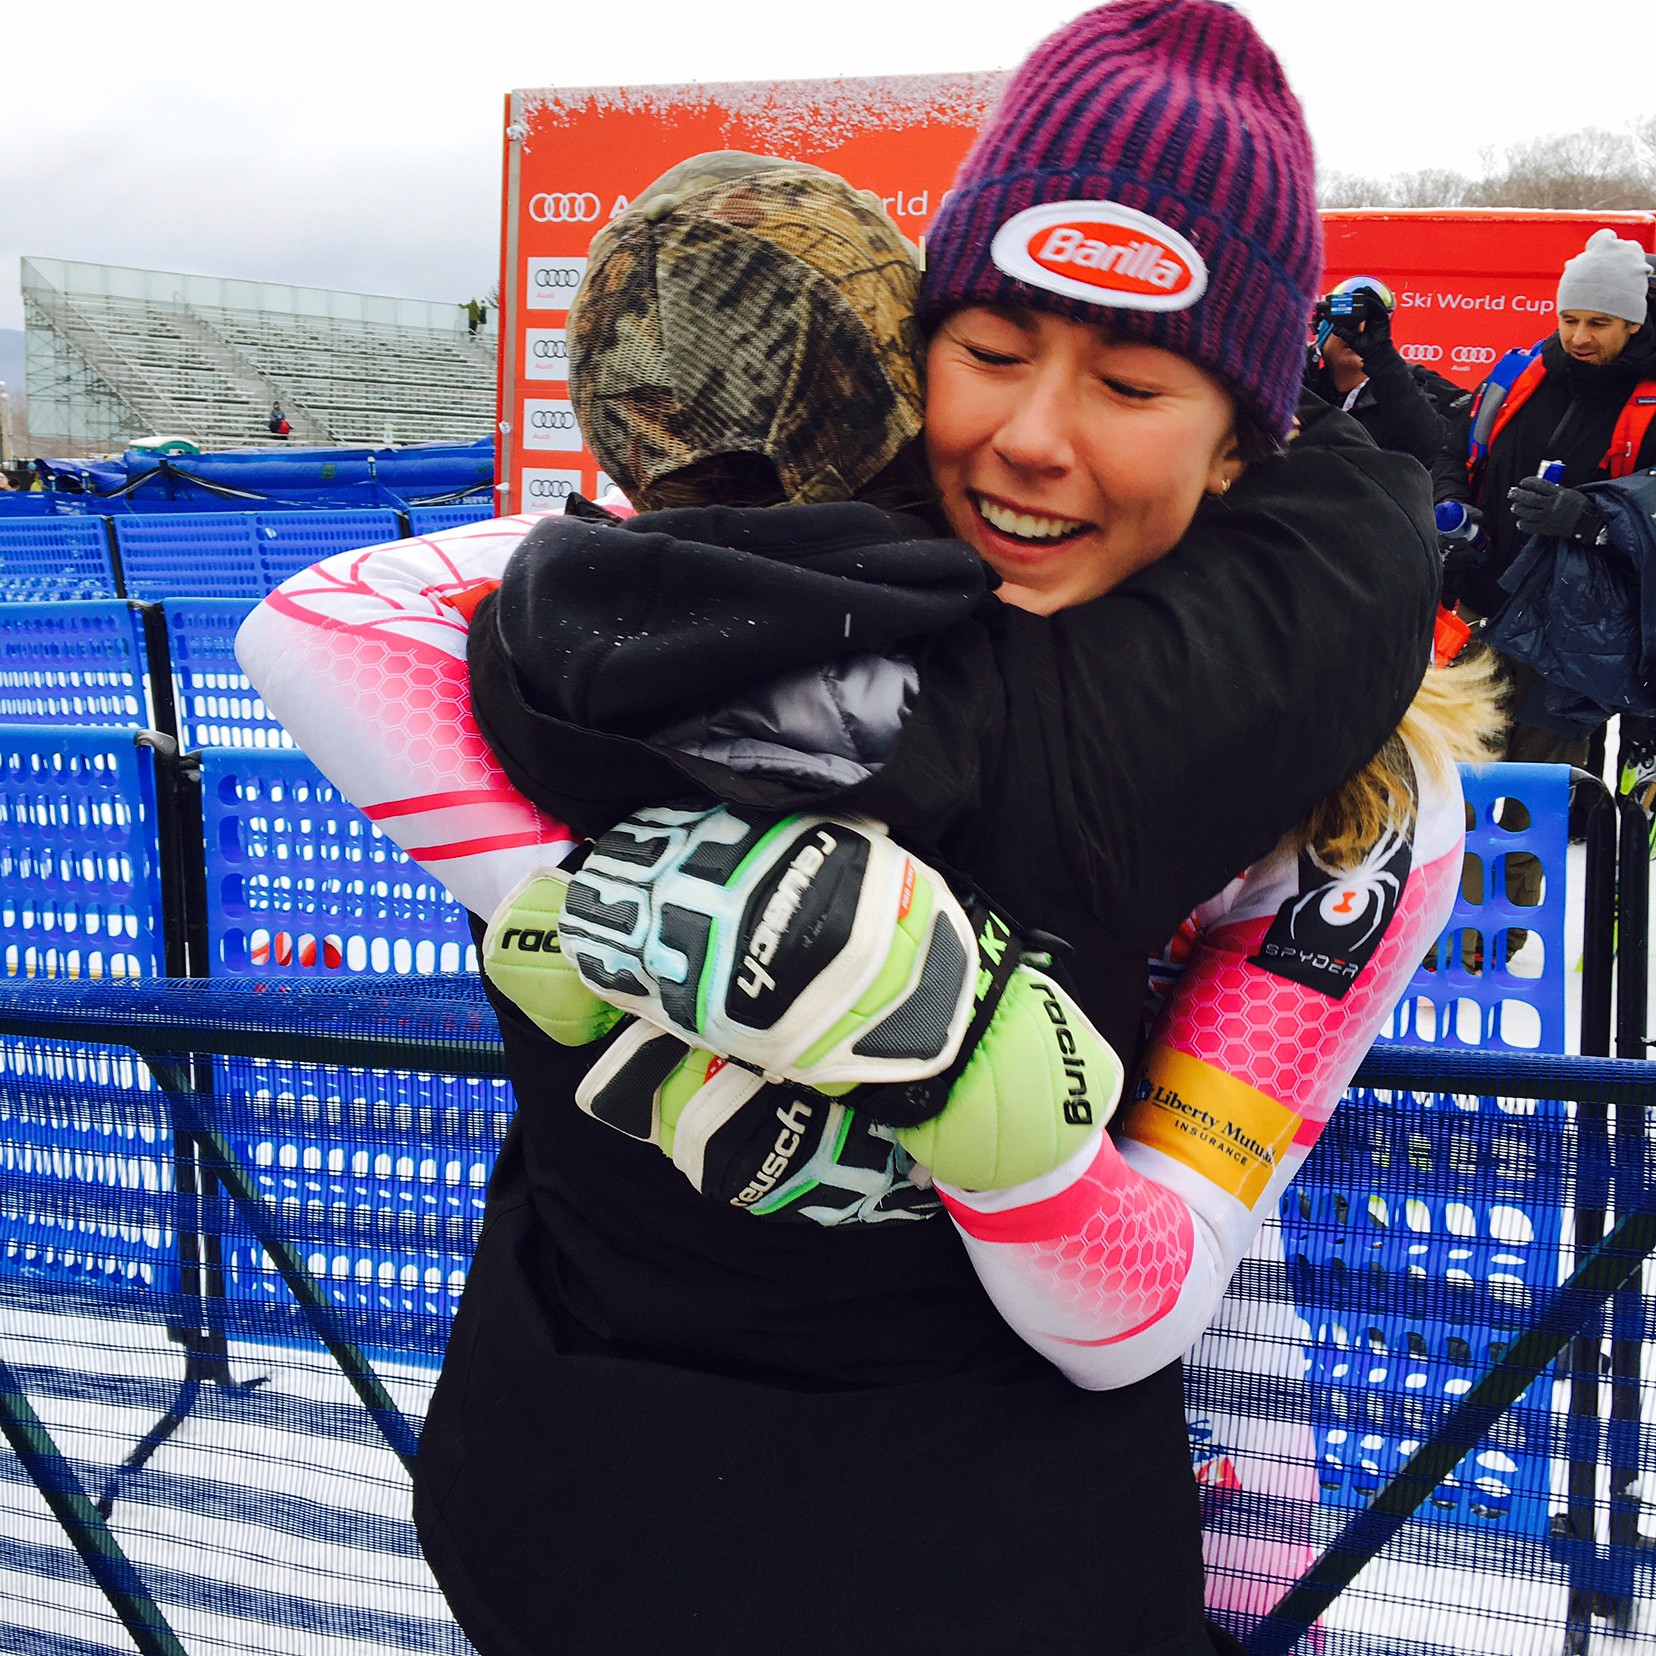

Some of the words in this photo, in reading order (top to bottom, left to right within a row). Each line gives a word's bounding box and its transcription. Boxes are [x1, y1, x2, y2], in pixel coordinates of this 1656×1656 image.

[882, 189, 928, 217] rld
[1038, 227, 1183, 290] Barilla
[1400, 292, 1432, 309] Ski
[1436, 293, 1505, 312] World
[1511, 295, 1554, 315] Cup
[534, 362, 553, 370] Audi
[736, 830, 838, 1000] reusch
[501, 927, 562, 954] rac
[1265, 943, 1359, 979] SPYDER
[967, 909, 1011, 1028] EKI
[1029, 982, 1093, 1125] racing
[1154, 1086, 1221, 1131] Liberty
[729, 1099, 813, 1208] reusch
[1174, 1119, 1249, 1167] INSURANCE
